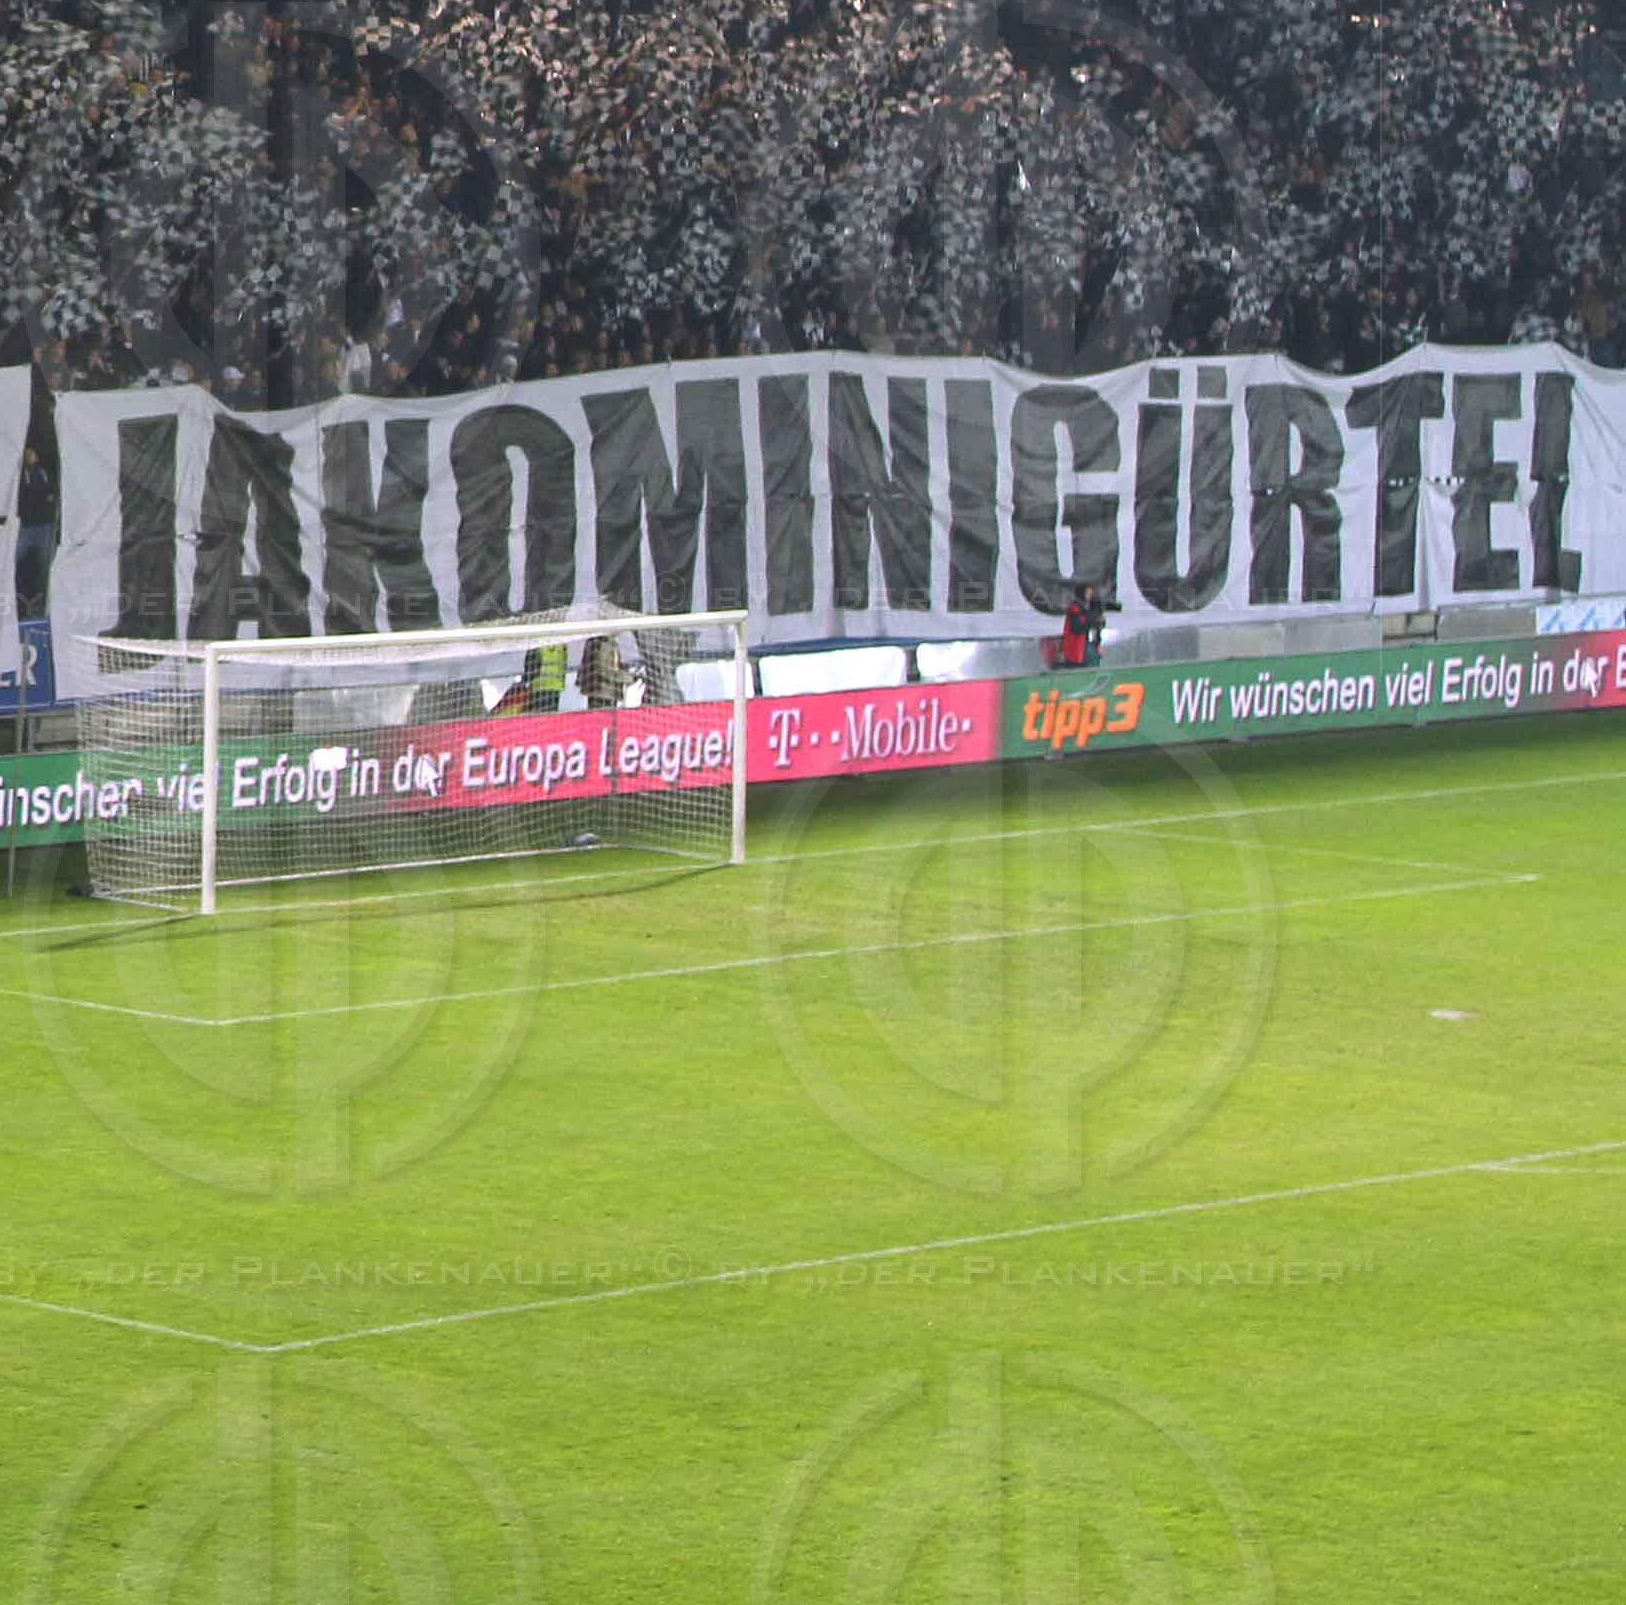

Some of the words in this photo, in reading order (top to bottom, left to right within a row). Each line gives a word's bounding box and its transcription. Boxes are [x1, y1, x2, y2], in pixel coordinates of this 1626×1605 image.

[97, 366, 1582, 674] JAKOMINIGÜRTEL
[1023, 682, 1147, 749] tipp3
[1171, 680, 1223, 724] Wir
[1229, 668, 1375, 719] wünschen
[1384, 661, 1432, 706] viel
[1441, 656, 1523, 709] Erfolg
[1530, 651, 1555, 695] in
[157, 759, 218, 814] vie
[232, 751, 340, 813] Erfolg
[349, 748, 381, 797] in
[462, 737, 586, 790] Europa
[598, 720, 735, 777] League!
